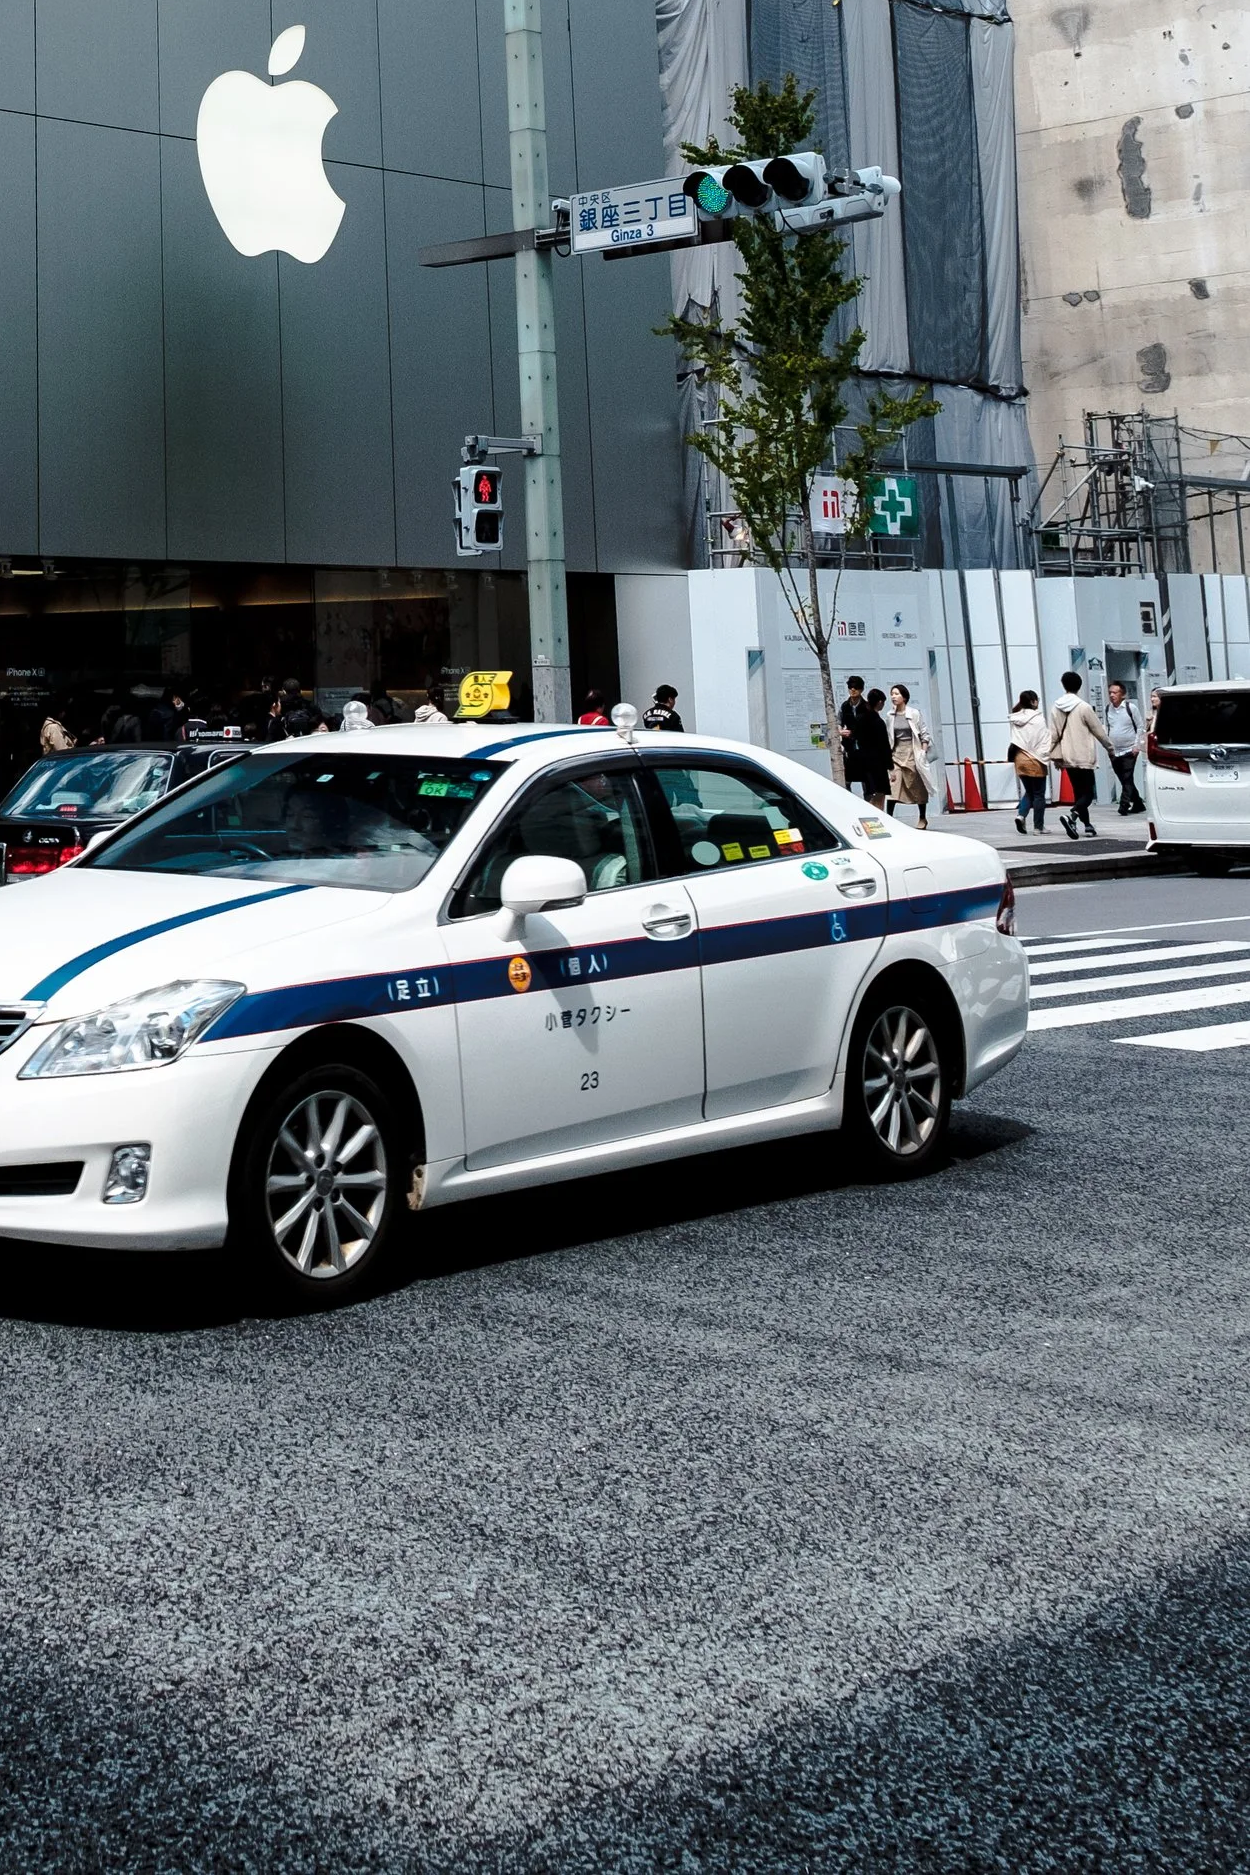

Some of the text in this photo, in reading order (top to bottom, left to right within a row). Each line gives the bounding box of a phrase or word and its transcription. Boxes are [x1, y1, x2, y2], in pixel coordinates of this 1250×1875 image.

[578, 192, 610, 206] 中央区
[579, 193, 687, 232] 銀座三丁目
[611, 224, 654, 243] Ginza 3
[545, 1005, 631, 1031] 小菅タクシー
[581, 1071, 600, 1091] 23
